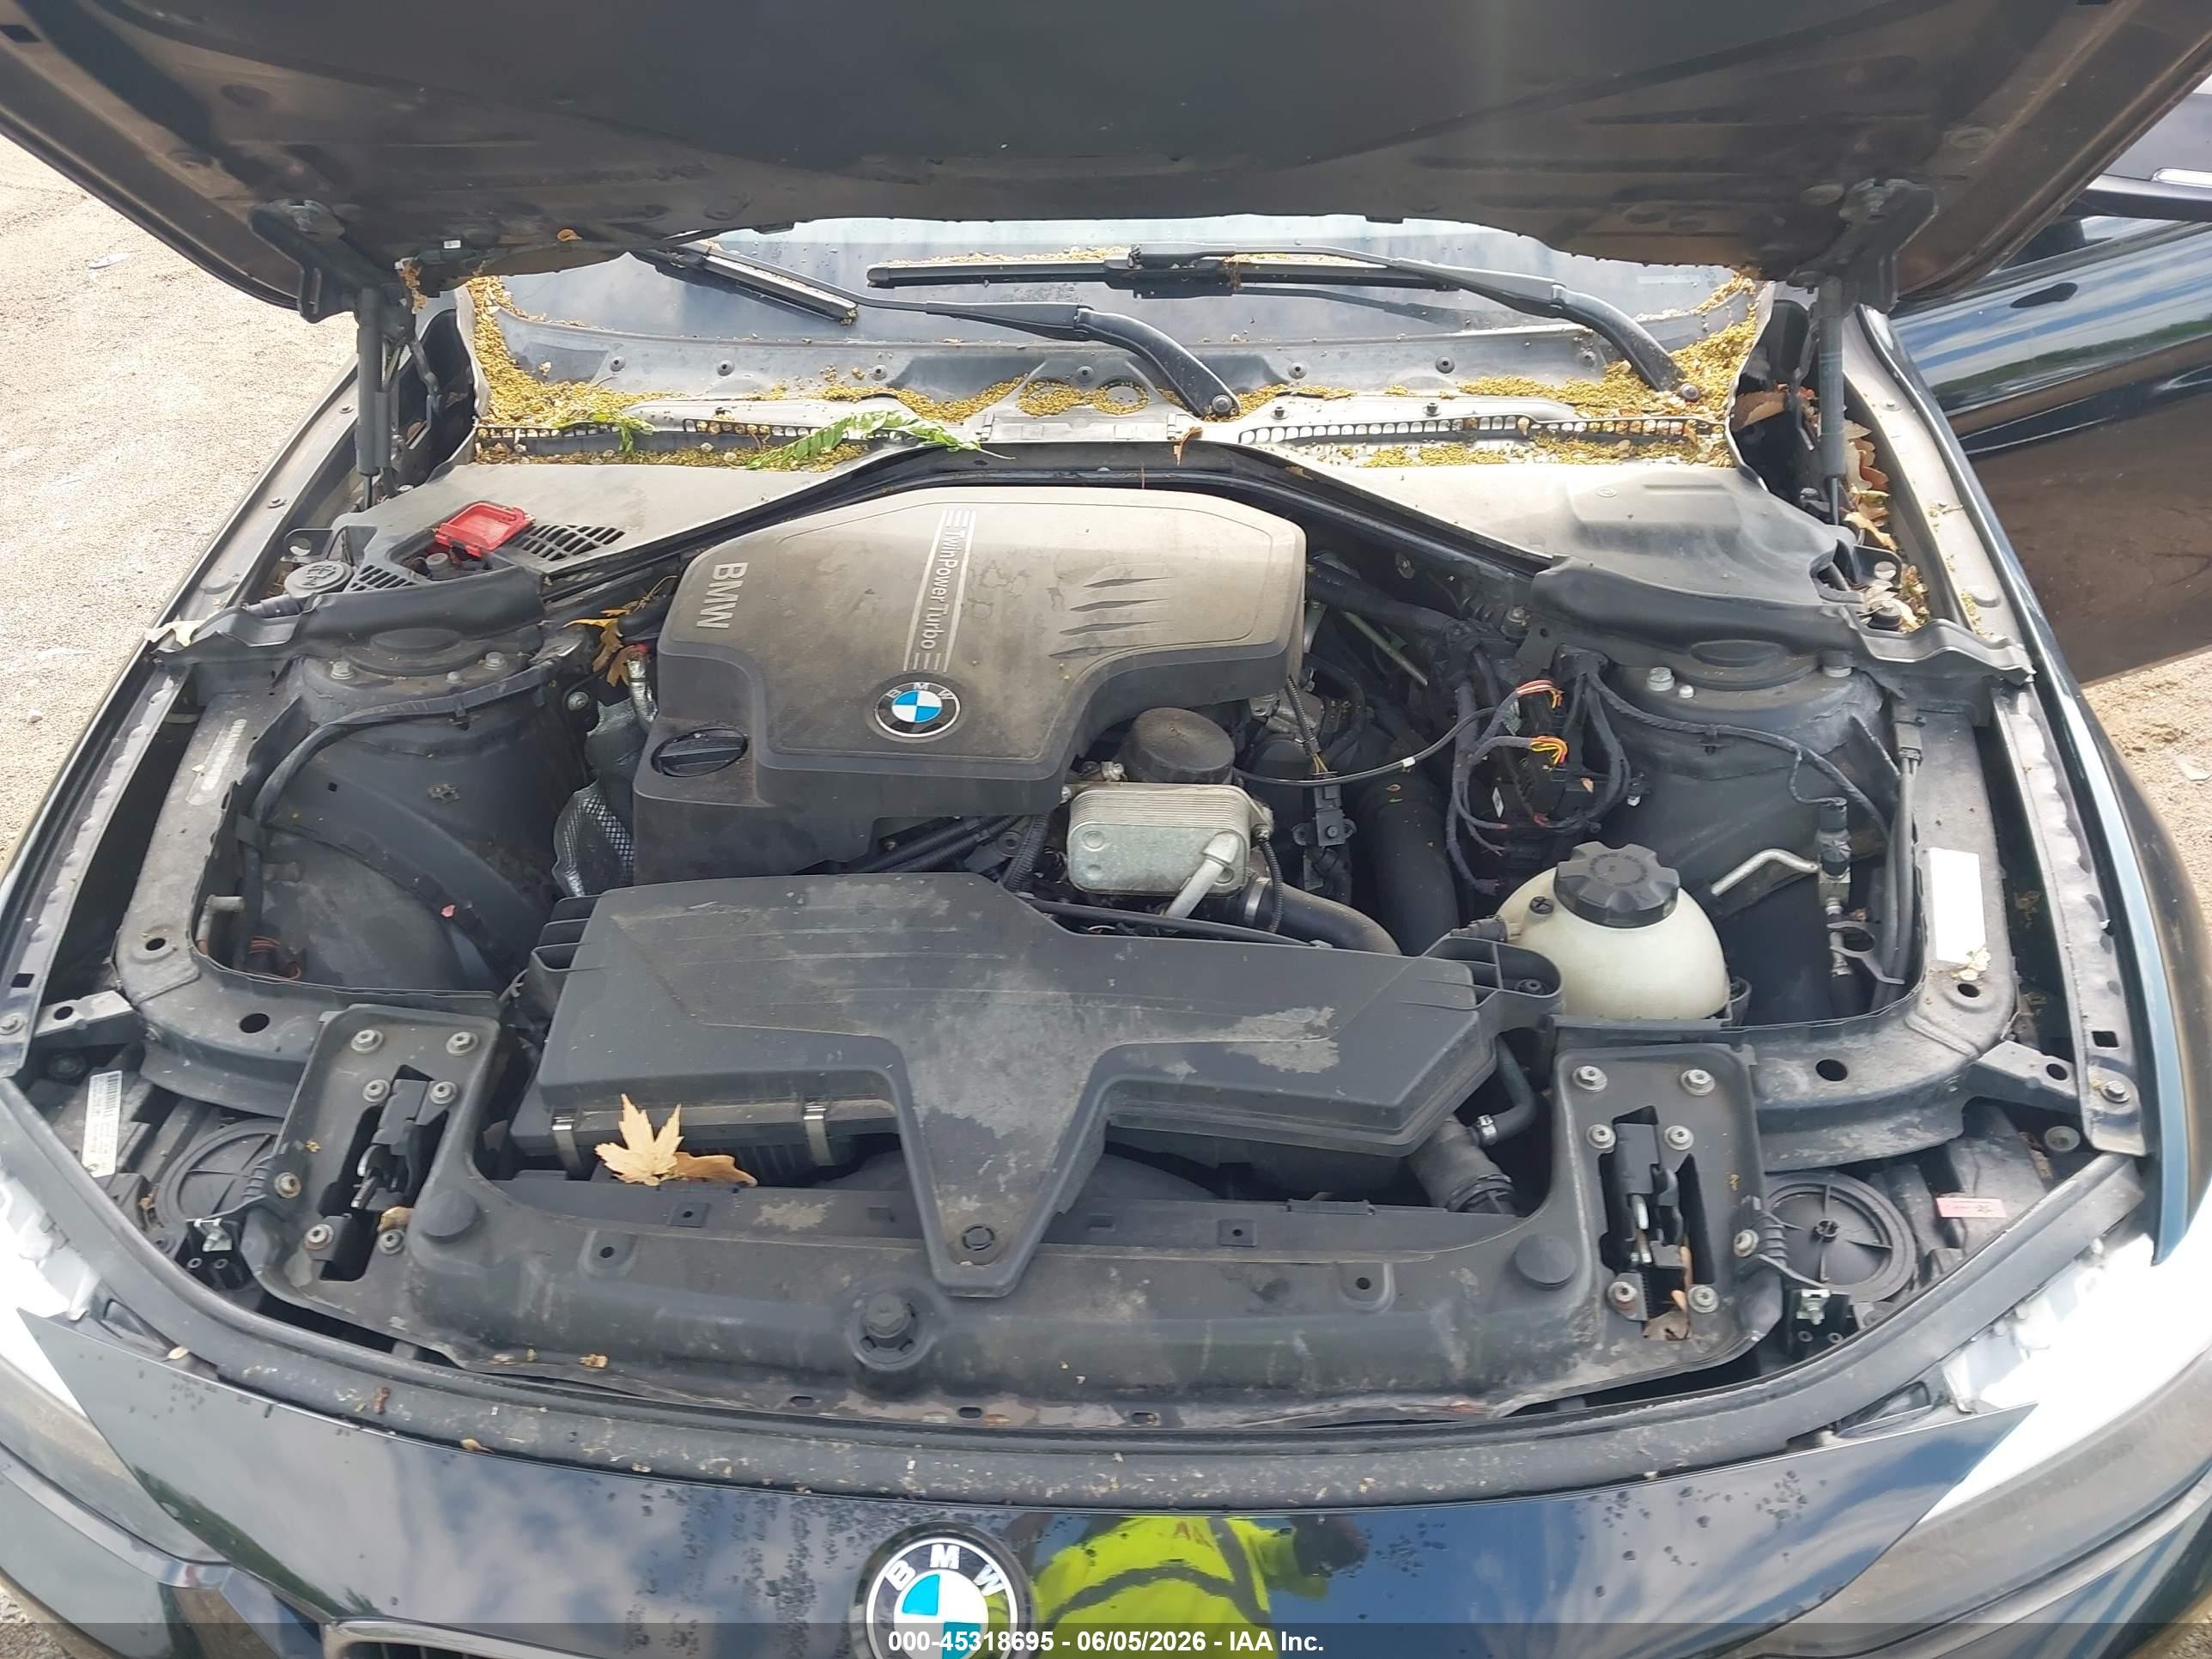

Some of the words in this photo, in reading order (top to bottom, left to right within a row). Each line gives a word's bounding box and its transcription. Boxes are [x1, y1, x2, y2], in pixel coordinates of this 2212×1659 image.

[929, 529, 967, 603] TwinPower
[696, 562, 750, 629] BMW
[920, 604, 950, 650] Turbo
[885, 682, 957, 700] BMW
[884, 1543, 1006, 1597] BMW
